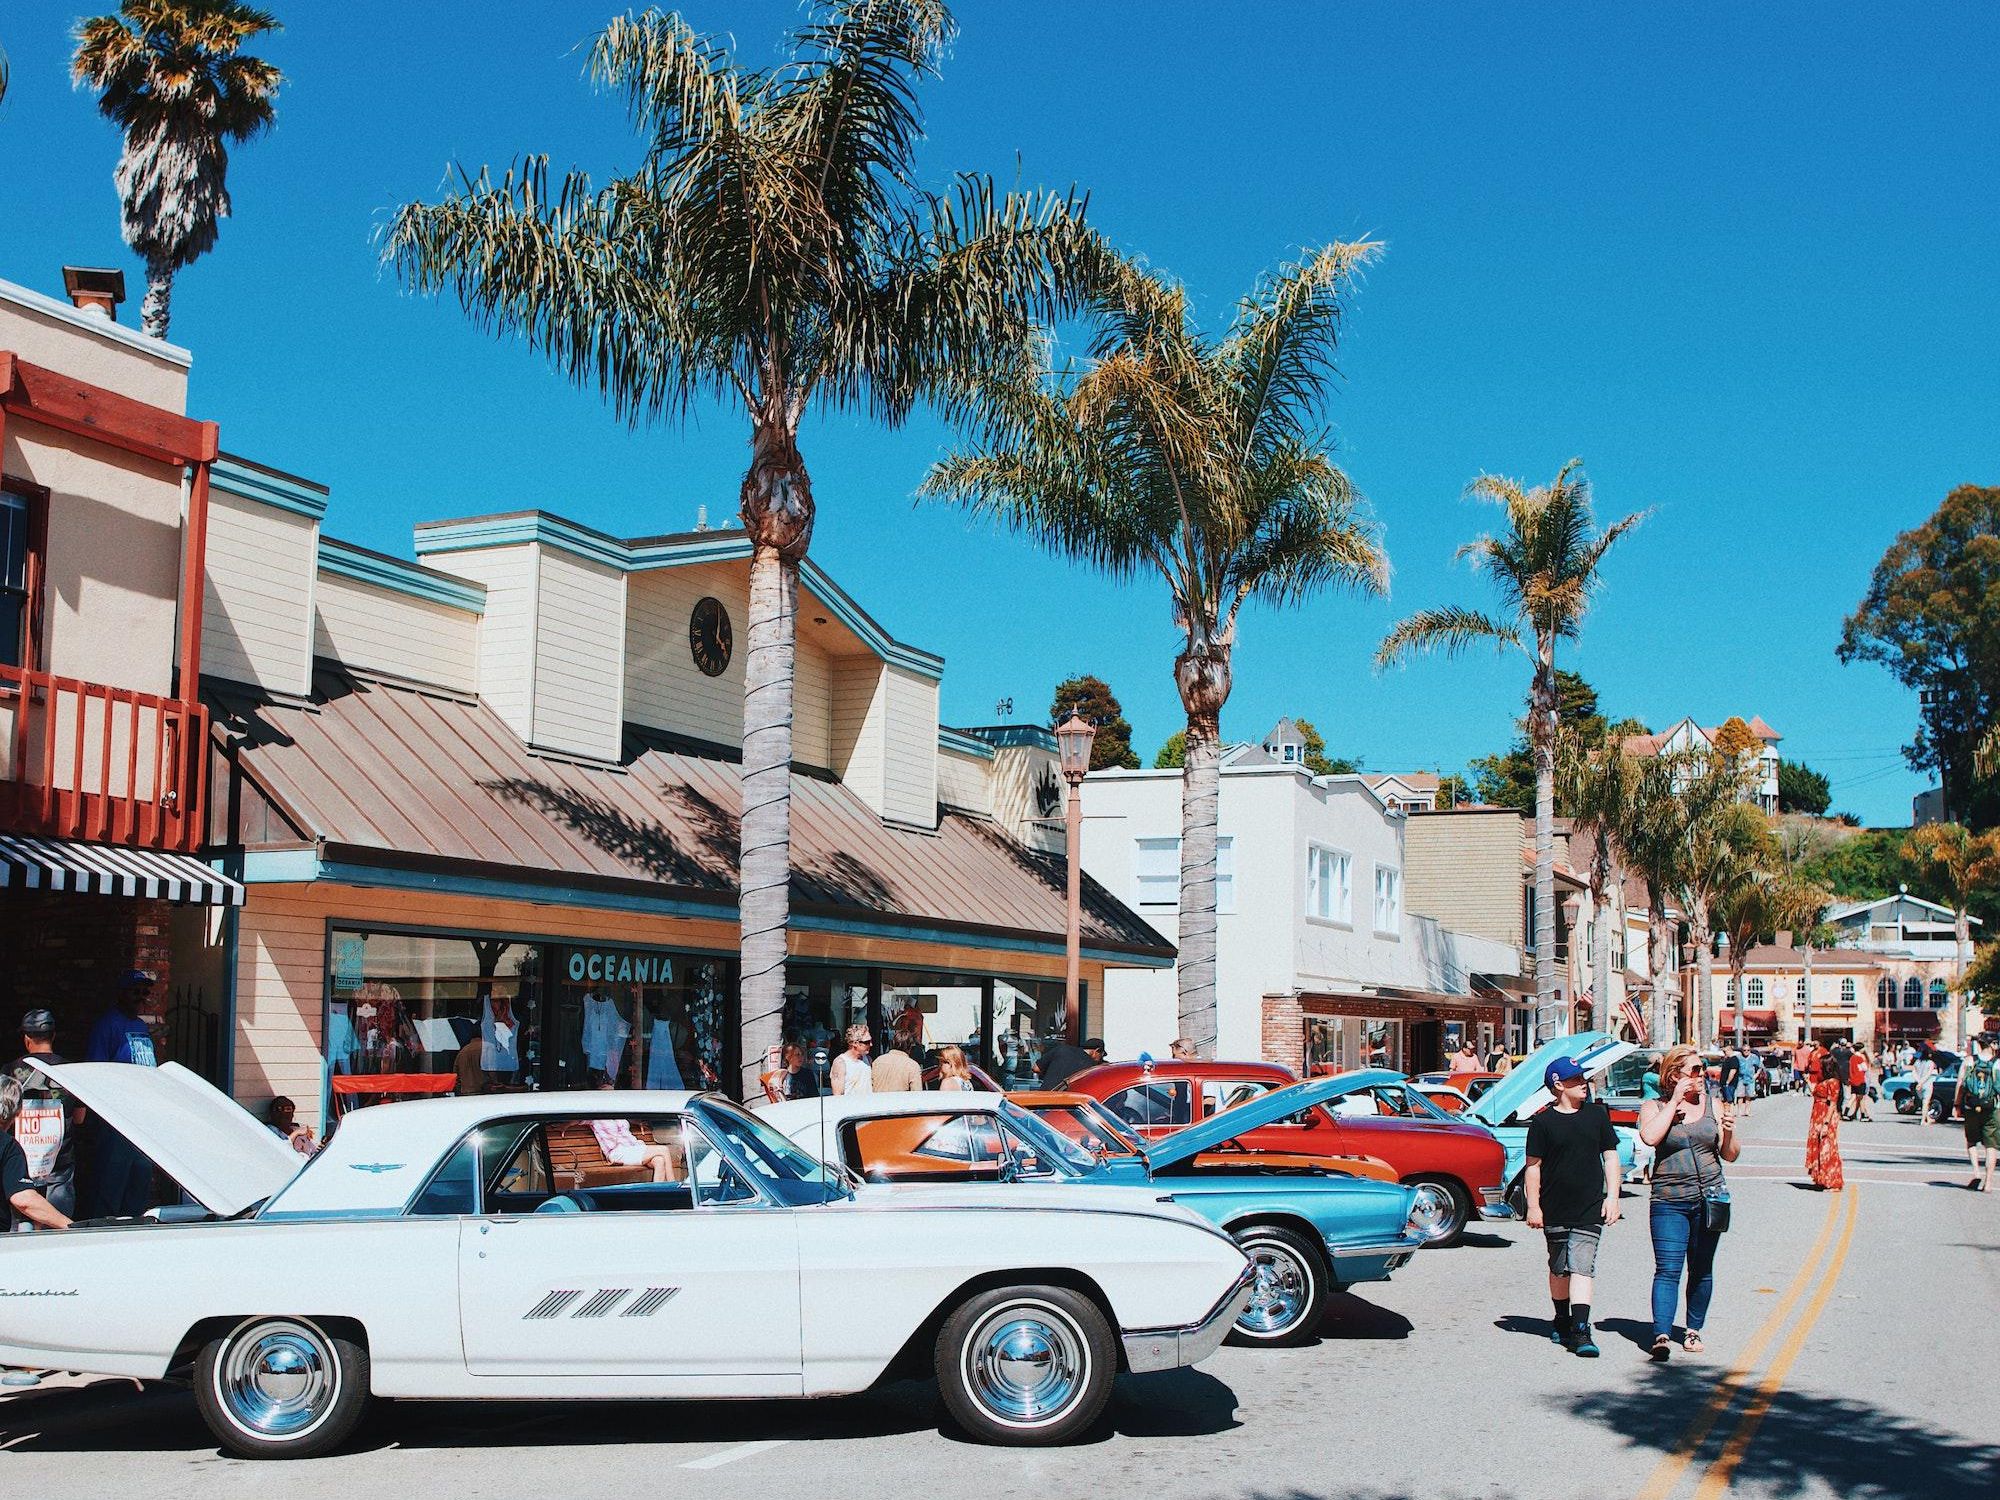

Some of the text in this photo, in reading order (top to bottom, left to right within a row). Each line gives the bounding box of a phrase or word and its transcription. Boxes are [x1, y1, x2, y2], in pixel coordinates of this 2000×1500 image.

[568, 952, 674, 984] OCEANIA
[22, 1118, 40, 1134] NO
[24, 1135, 57, 1145] PARKING
